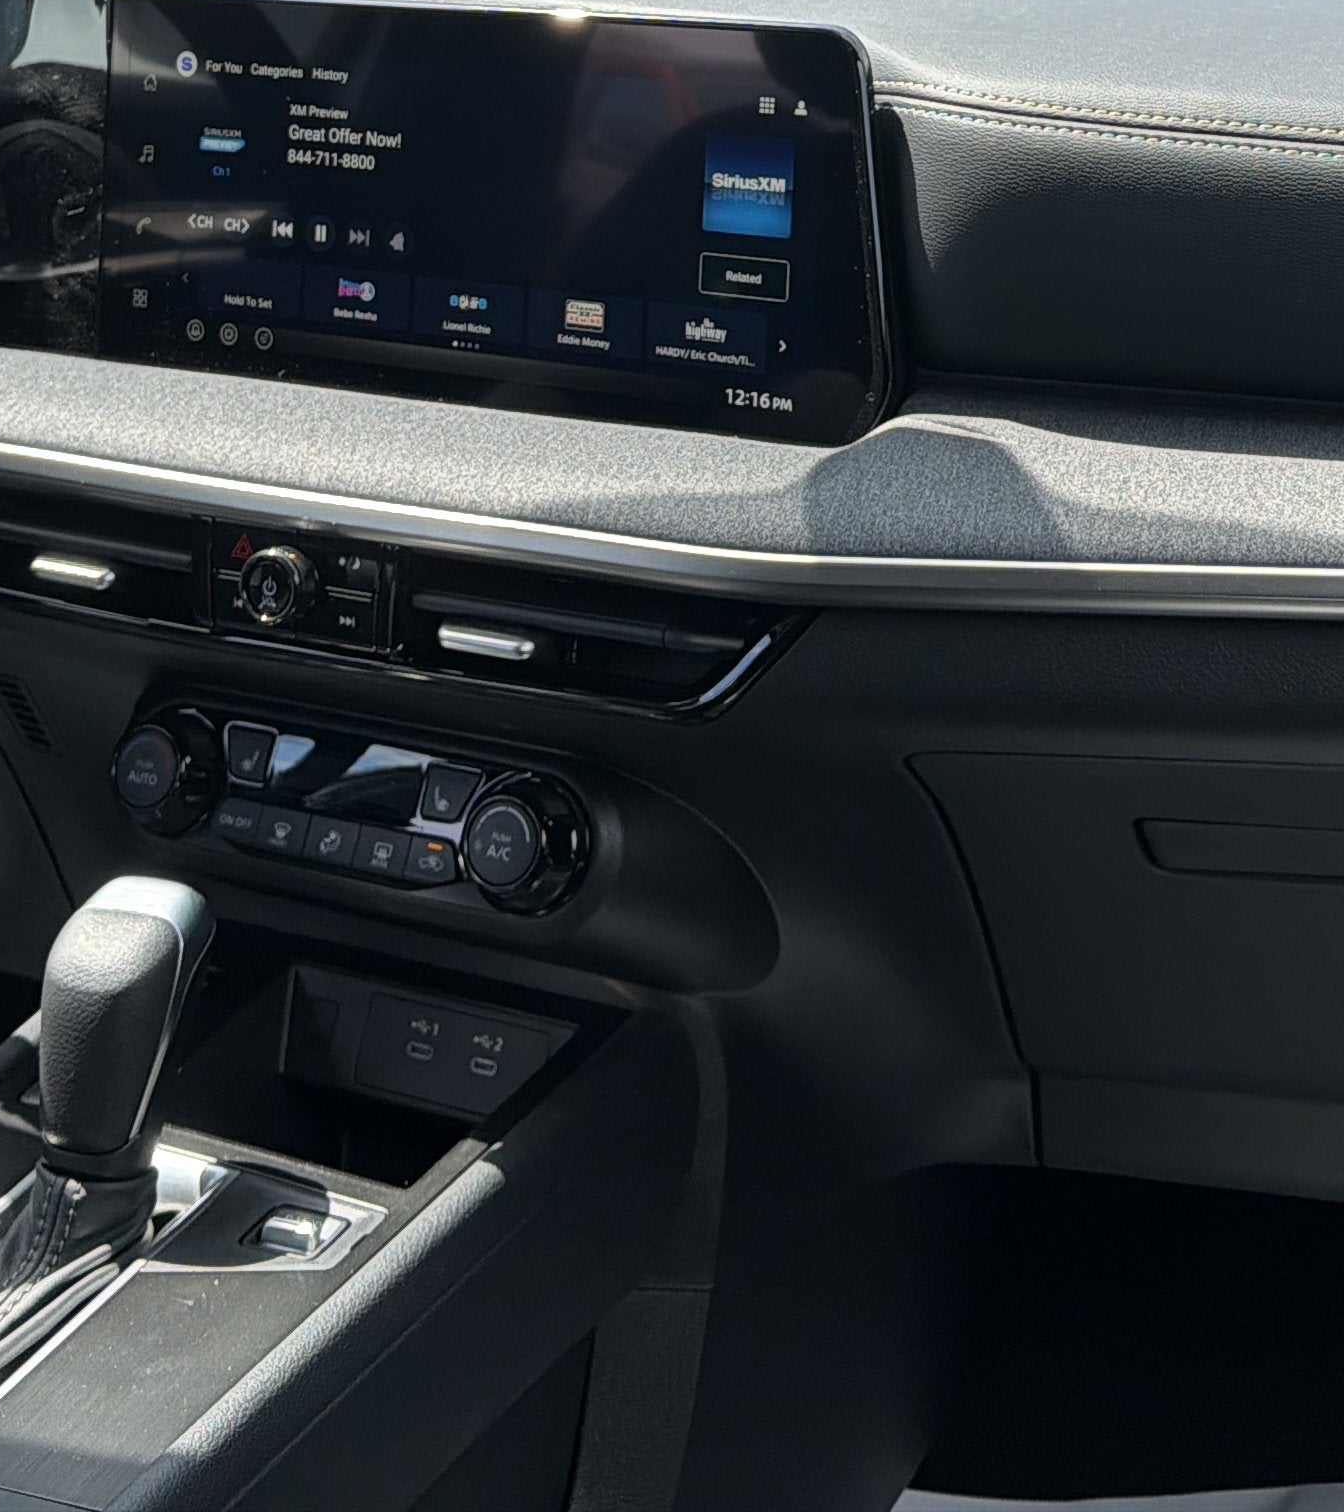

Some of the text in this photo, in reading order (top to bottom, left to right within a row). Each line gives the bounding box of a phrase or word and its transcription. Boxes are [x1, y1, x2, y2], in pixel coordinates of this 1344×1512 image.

[205, 60, 243, 75] For You
[250, 63, 304, 80] Categories
[312, 67, 349, 85] History
[289, 103, 349, 121] XM Preview
[288, 124, 403, 148] Great Offer Now!
[287, 148, 376, 171] 844-711-8800
[212, 165, 224, 176] Ch
[711, 172, 787, 193] SiriusXM
[725, 270, 763, 285] Related
[224, 293, 273, 310] Hold To Set
[442, 320, 492, 336] Lionel Richie
[684, 321, 728, 343] highway
[557, 333, 611, 351] Eddie Money
[690, 349, 706, 362] Eric
[725, 388, 793, 412] 12:16 PM
[127, 769, 158, 786] AUTO
[486, 846, 512, 862] A/C
[492, 1037, 504, 1052] 2
